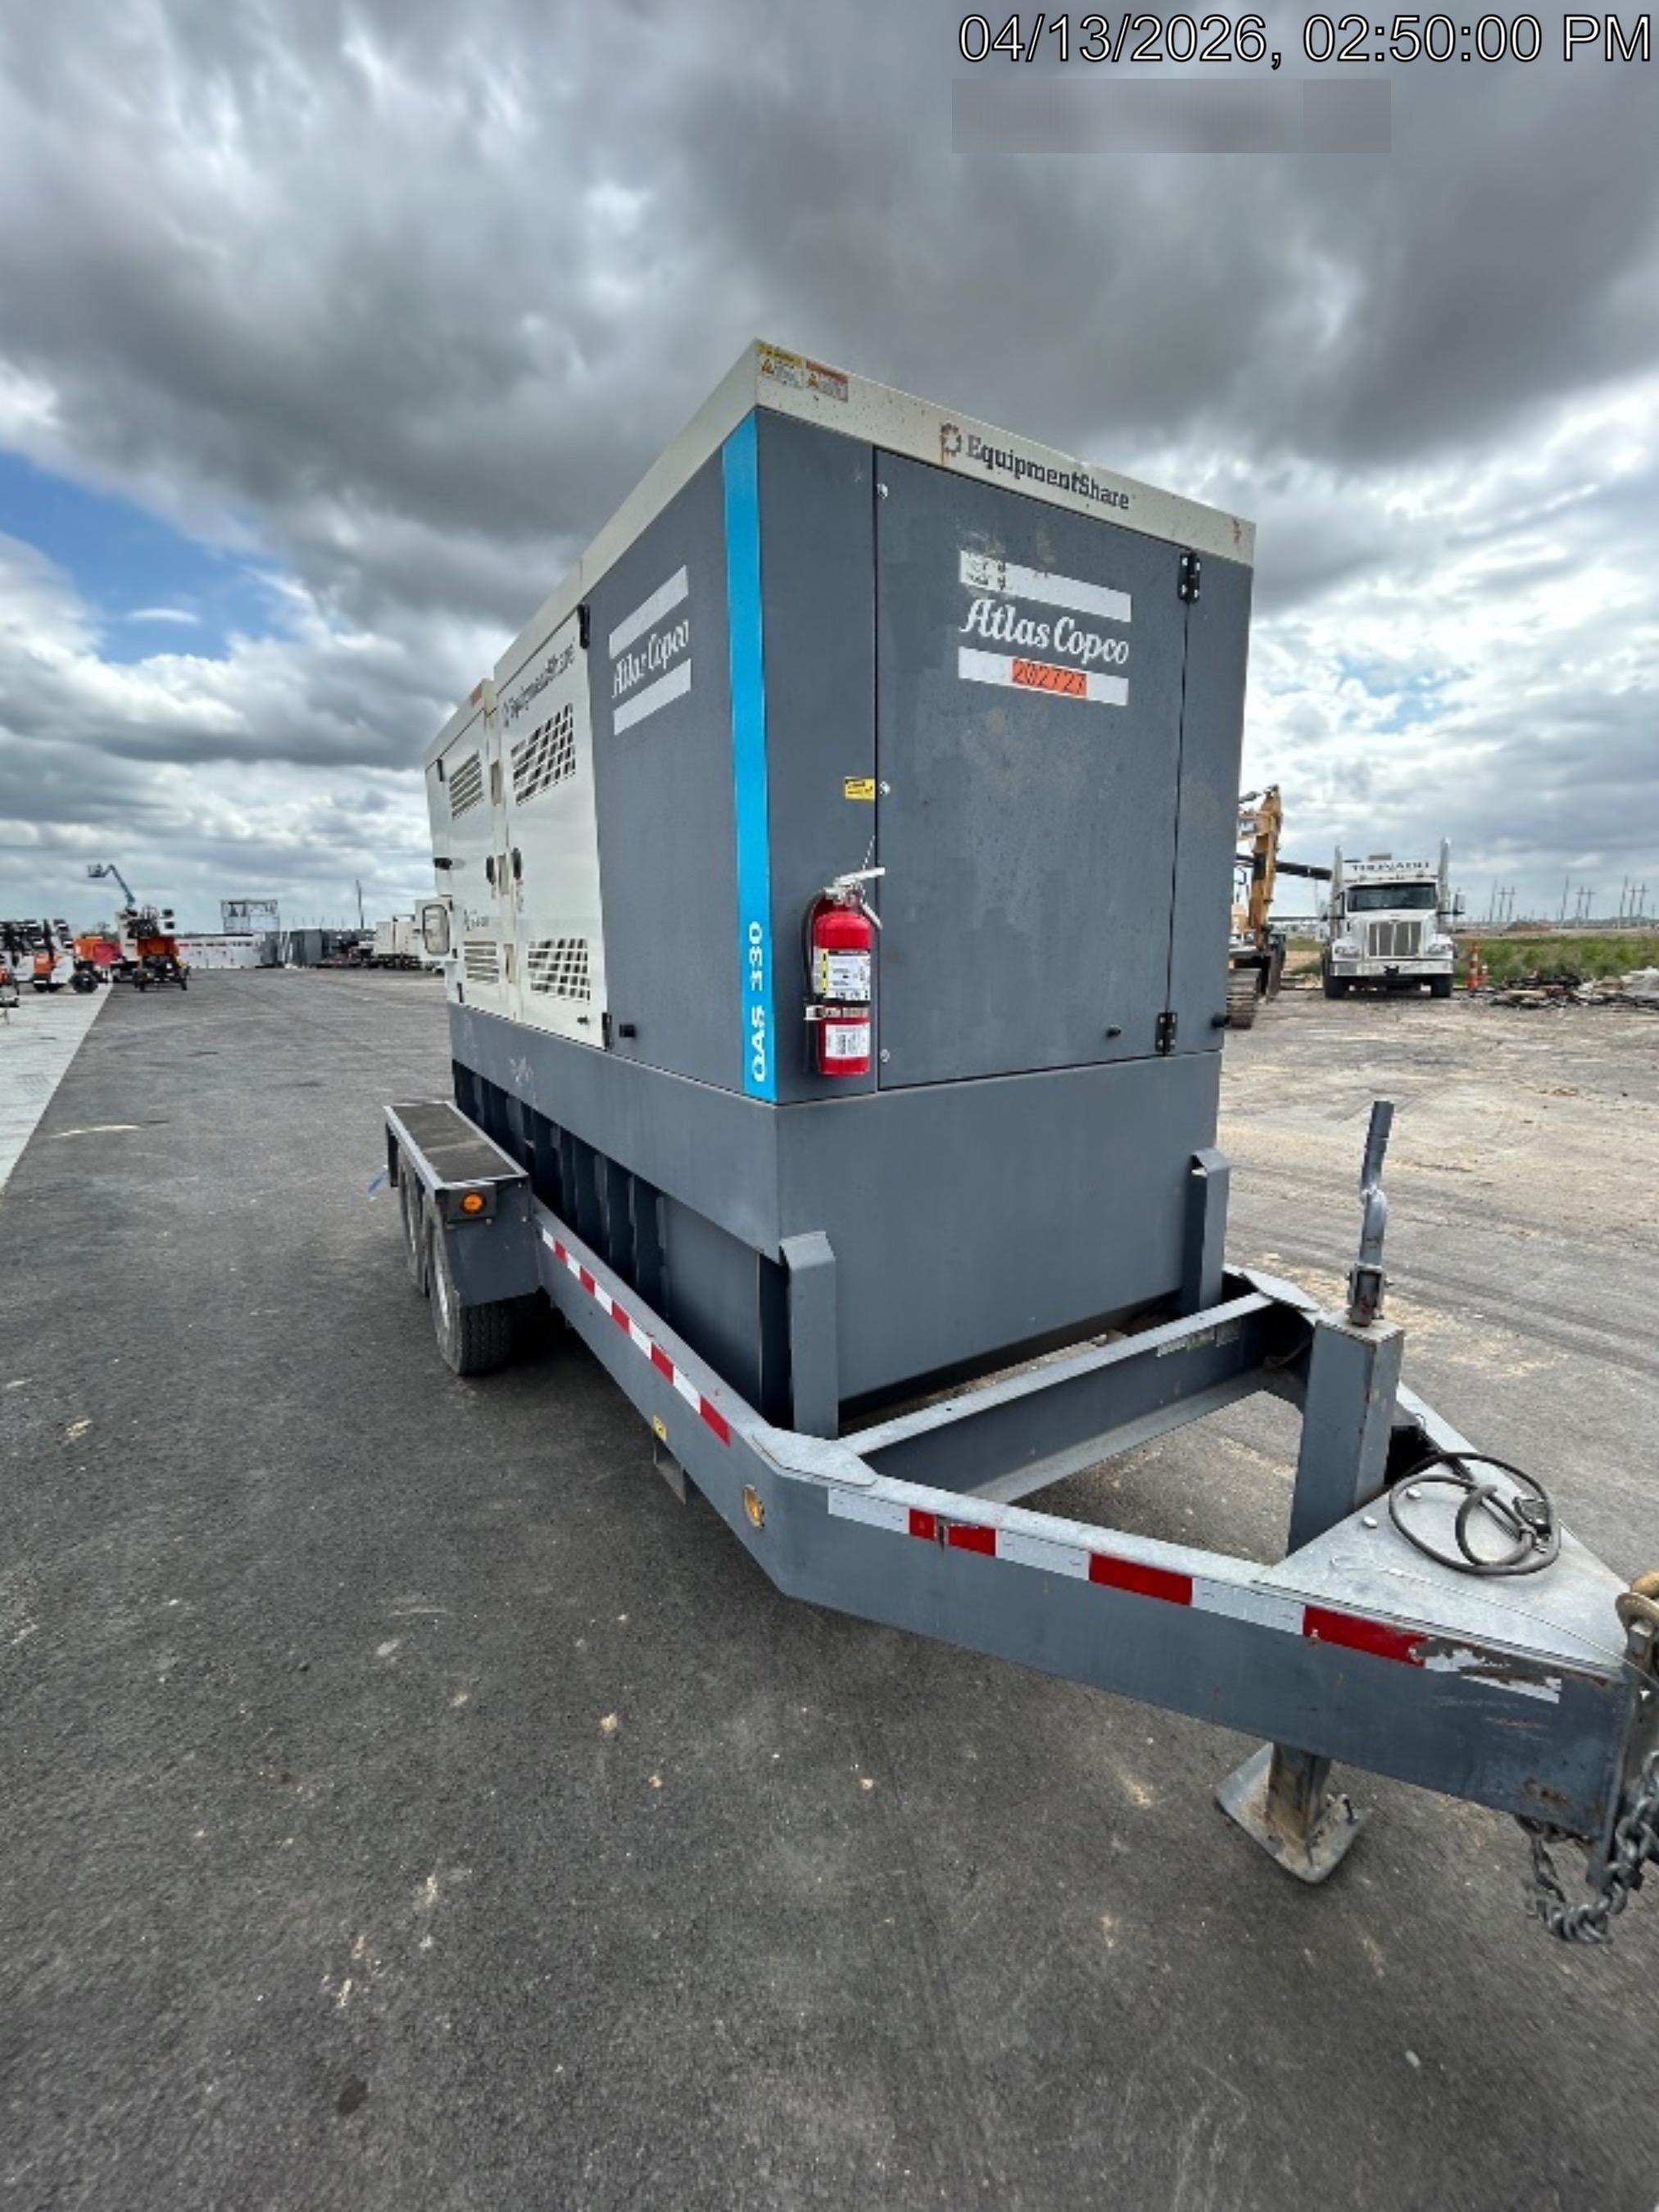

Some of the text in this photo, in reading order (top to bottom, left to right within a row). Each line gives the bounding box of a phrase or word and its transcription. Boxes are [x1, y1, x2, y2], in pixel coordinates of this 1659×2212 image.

[967, 434, 1130, 510] EquipmentShare
[611, 619, 689, 699] Atlas Copco
[959, 599, 1130, 664] Atlas Copco
[749, 921, 764, 991] 330
